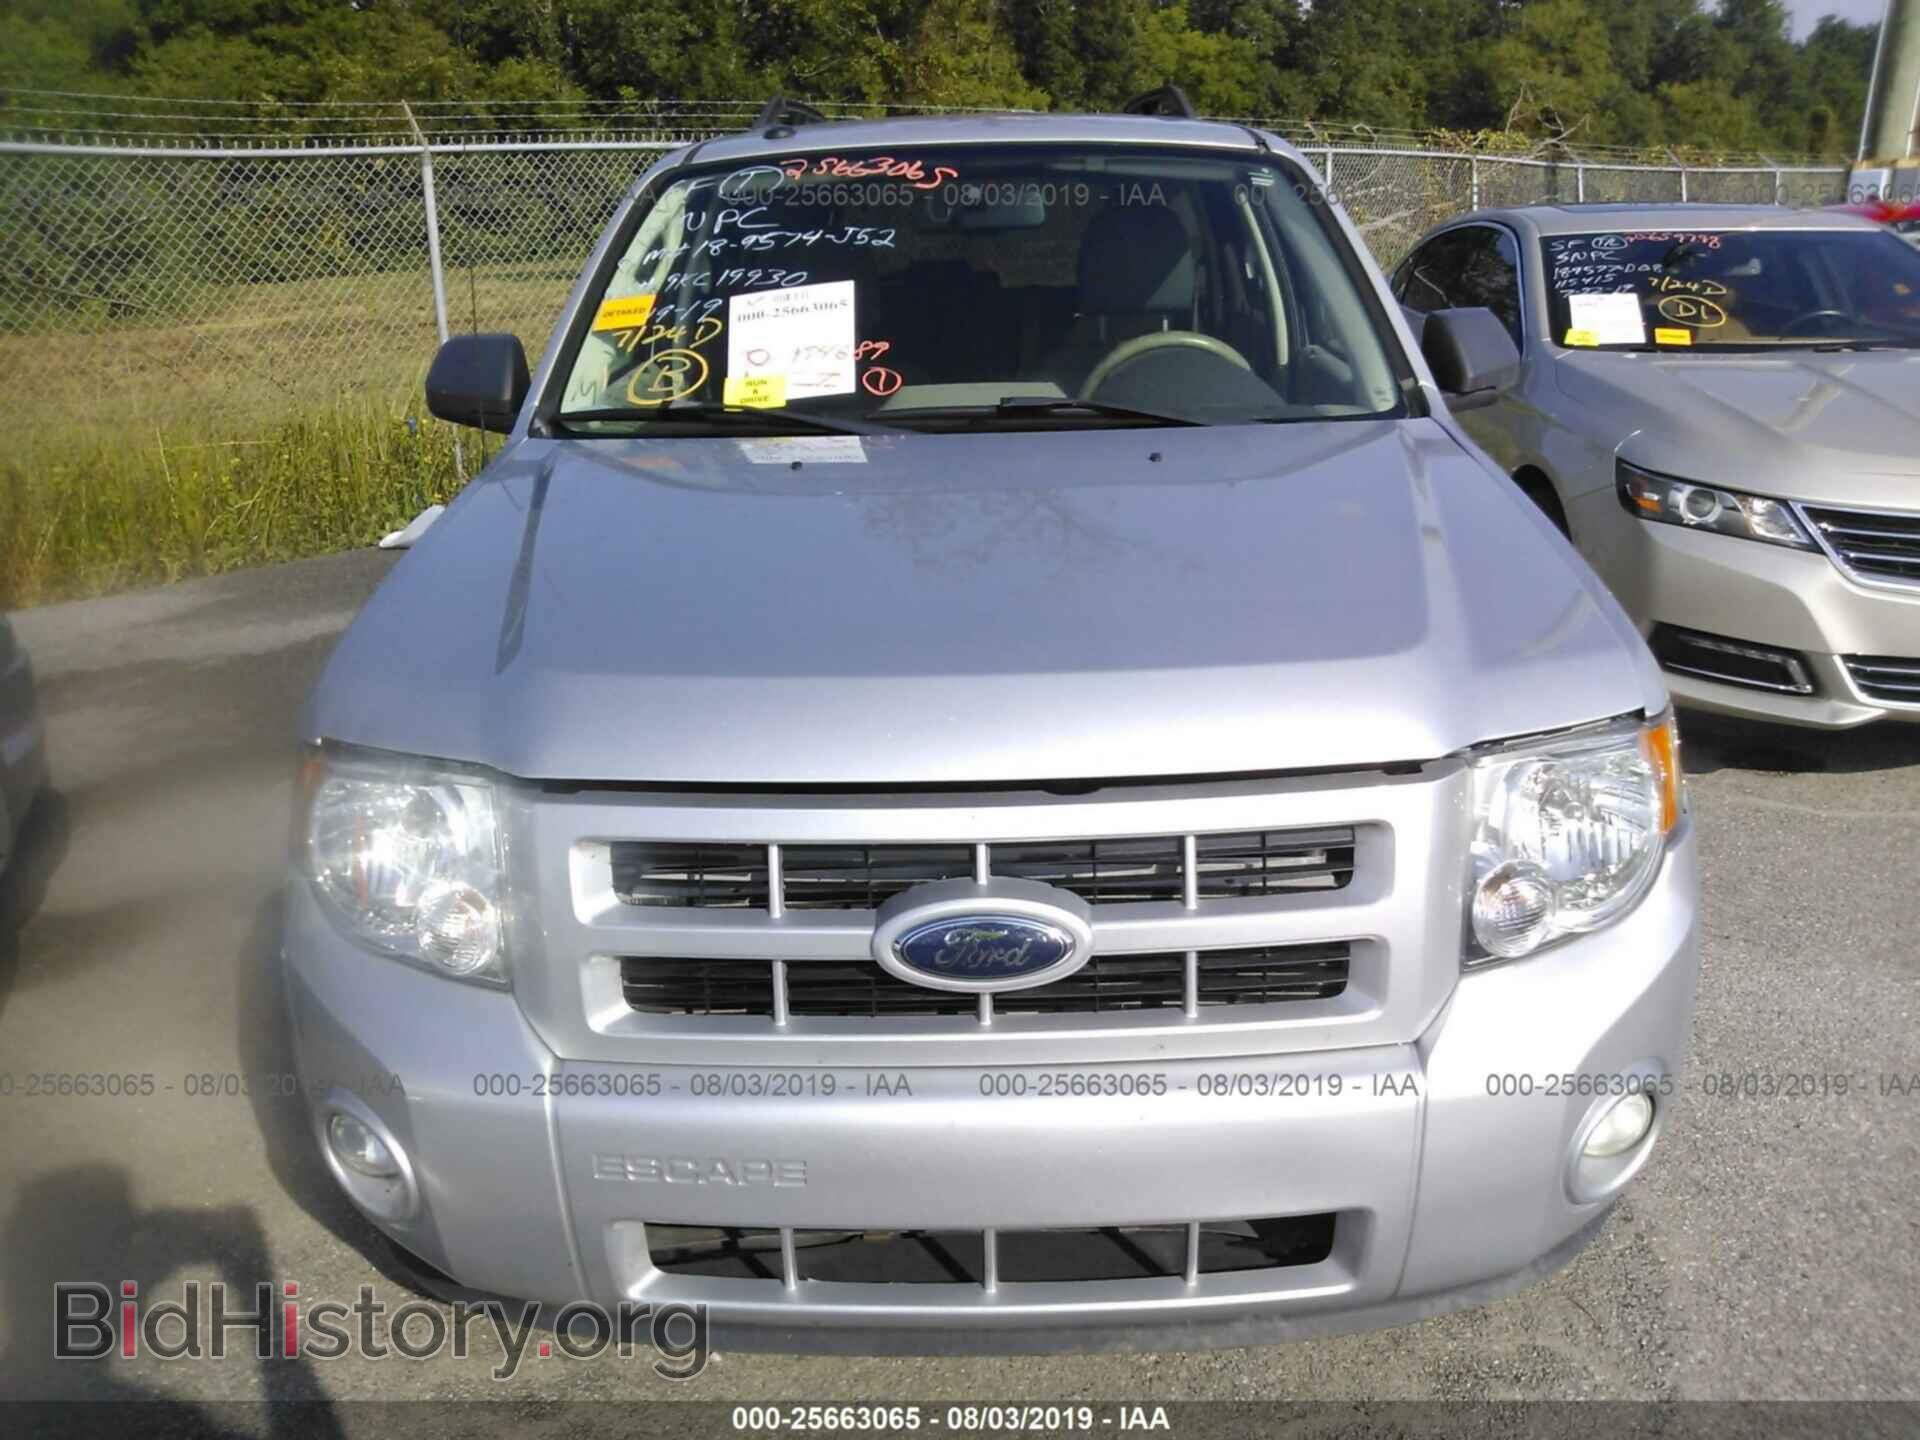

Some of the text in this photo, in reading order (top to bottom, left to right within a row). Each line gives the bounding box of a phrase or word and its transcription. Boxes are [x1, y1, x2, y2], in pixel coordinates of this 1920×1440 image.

[780, 156, 959, 189] 25663065
[935, 929, 1032, 968] Ford
[592, 1153, 808, 1188] ESCAPE
